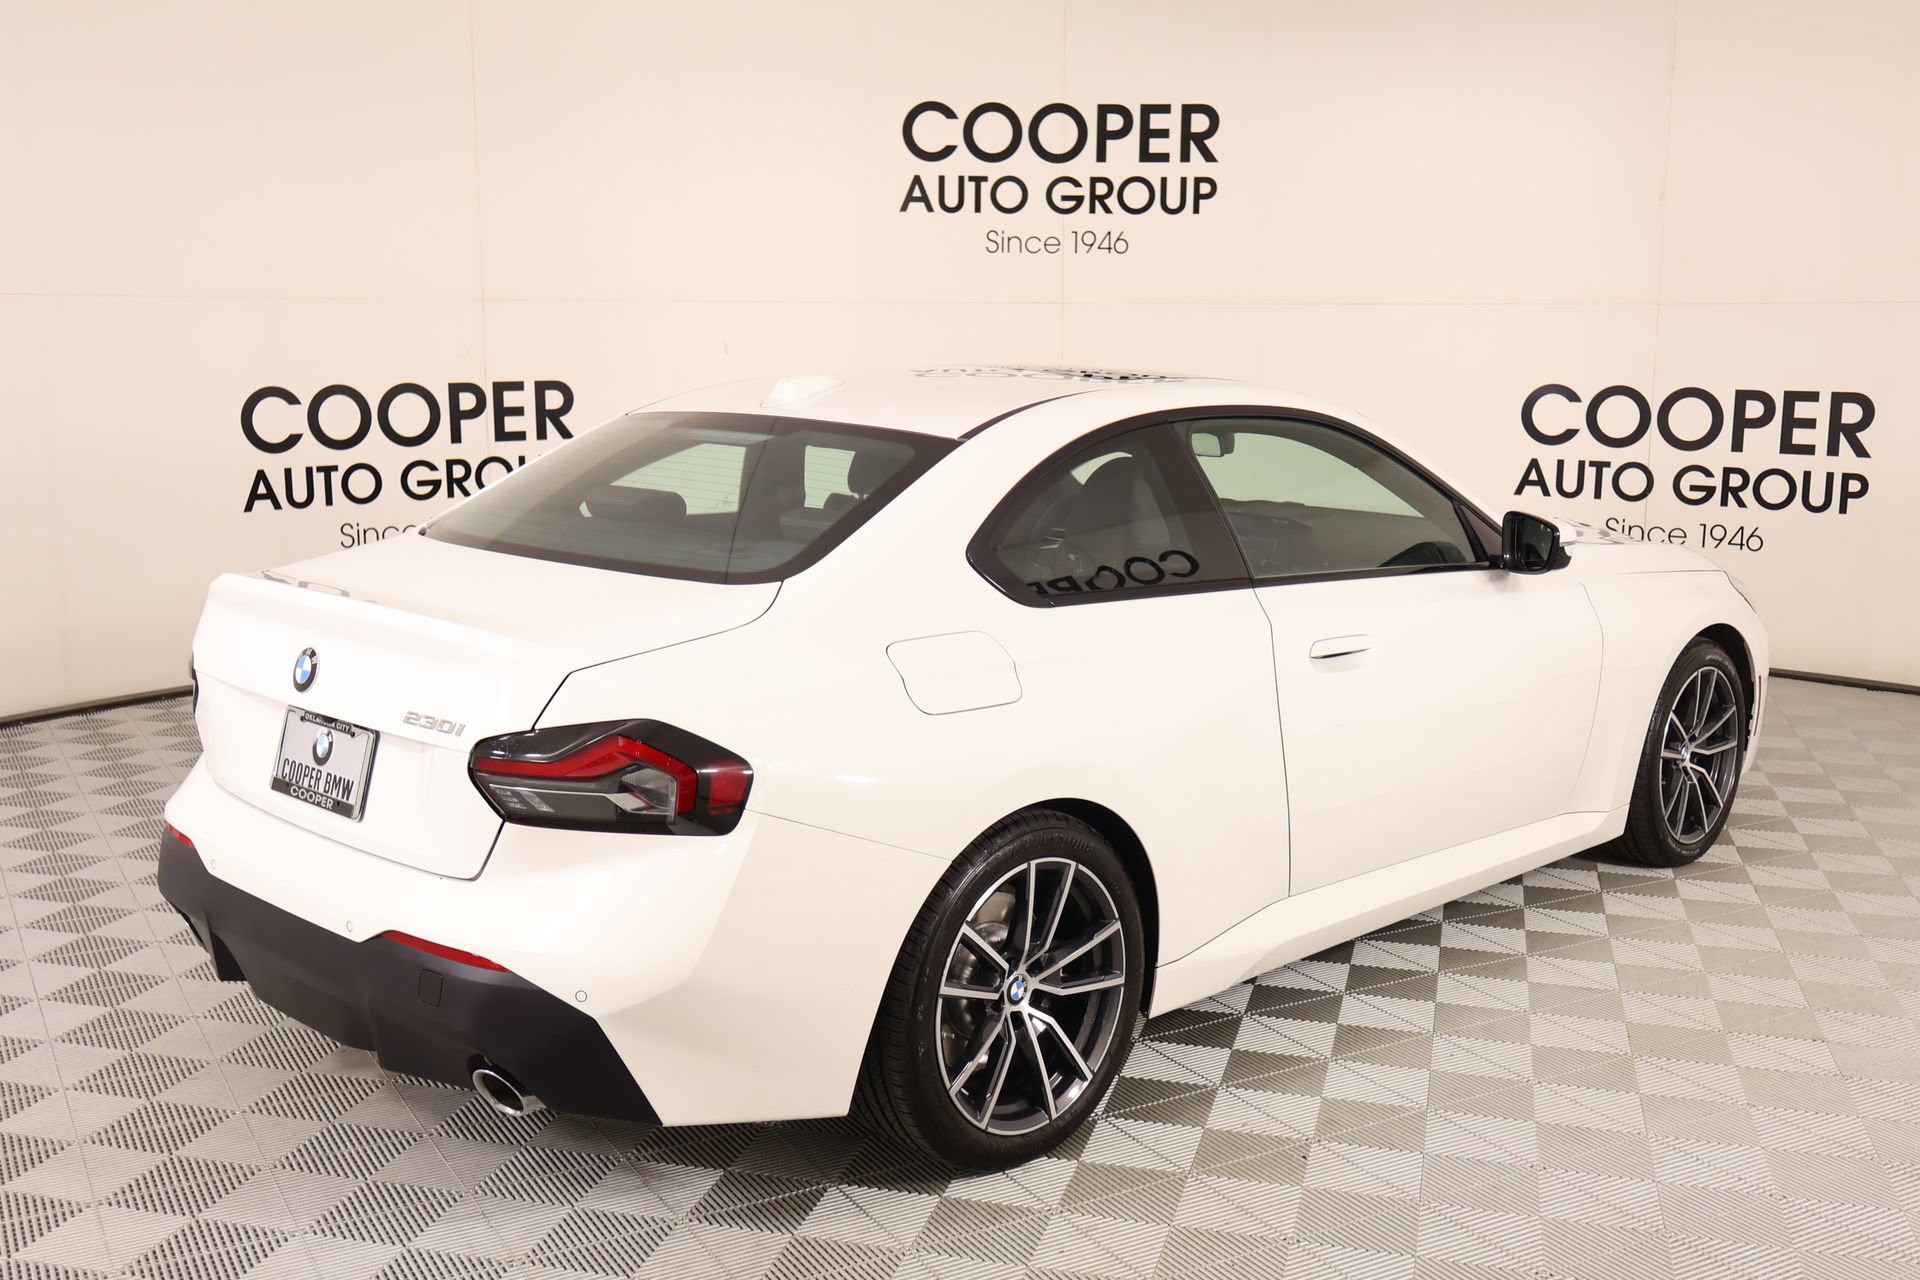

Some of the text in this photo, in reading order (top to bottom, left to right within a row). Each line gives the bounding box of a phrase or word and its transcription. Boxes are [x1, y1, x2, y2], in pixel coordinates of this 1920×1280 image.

[902, 100, 1220, 164] COOPER
[899, 174, 1218, 215] AUTO GROUP
[985, 229, 1129, 255] Since 1946
[240, 380, 575, 455] COOPER
[1520, 383, 1876, 459] COOPER
[243, 462, 383, 513] AUTO
[1513, 457, 1870, 515] AUTO GROUP
[1699, 523, 1764, 552] 1946
[335, 722, 350, 732] CITY
[281, 758, 355, 802] COOPER BMW
[290, 786, 334, 810] COOPER
